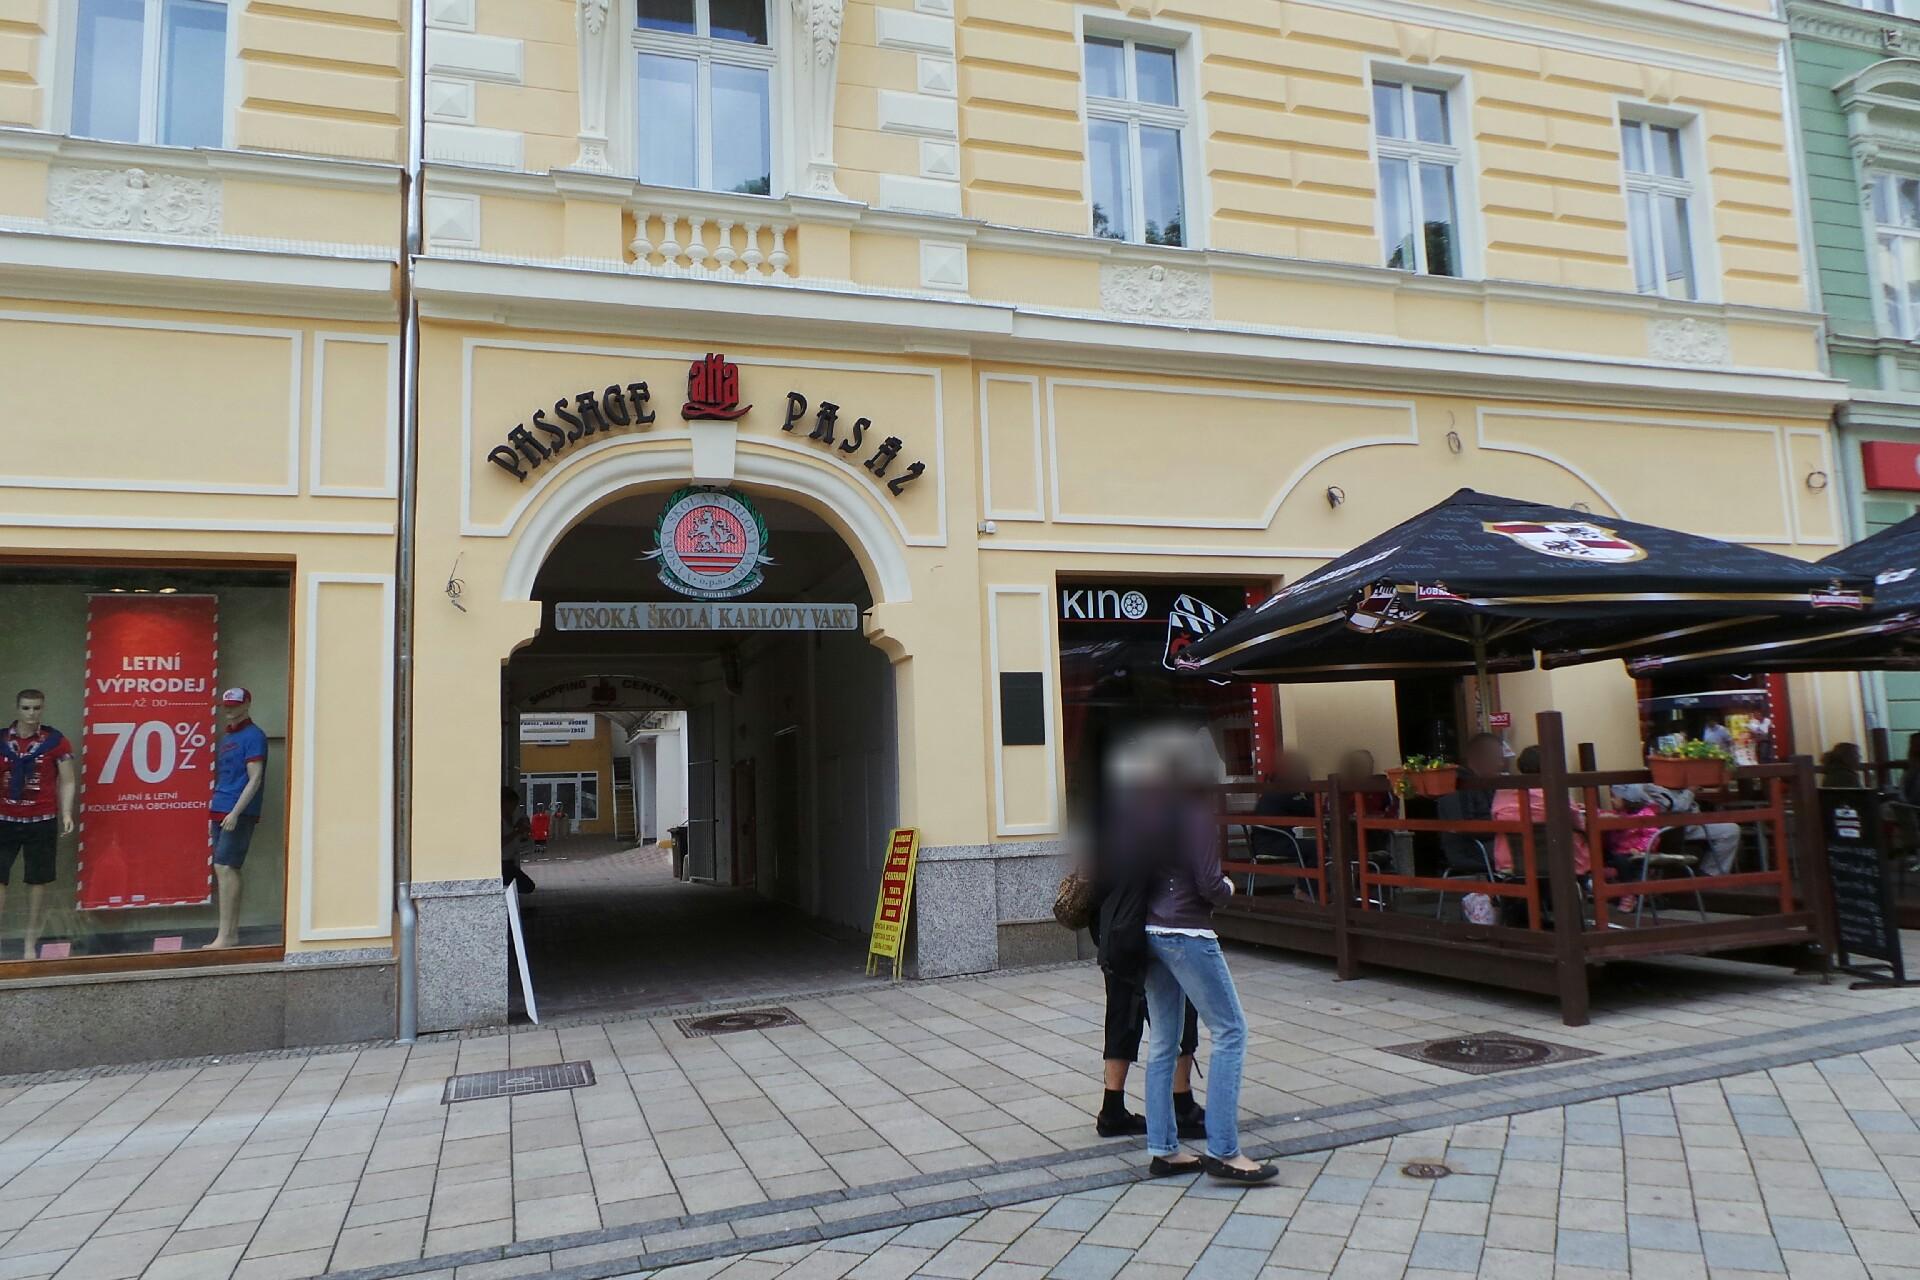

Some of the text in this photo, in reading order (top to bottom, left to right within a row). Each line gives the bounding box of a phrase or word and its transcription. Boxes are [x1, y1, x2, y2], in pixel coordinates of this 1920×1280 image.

[486, 380, 657, 484] PASSAGE
[558, 602, 856, 629] VYSOKÁ ŠKOLA KARLOVY VARY
[122, 651, 181, 671] LETNÍ
[96, 673, 206, 694] VÝPRODEJ
[132, 697, 168, 708] AŽ DO
[178, 748, 197, 770] Z
[117, 791, 178, 801] JARNÍ & LETNÍ
[87, 801, 206, 812] KOLEKCE NA OBCHODECH
